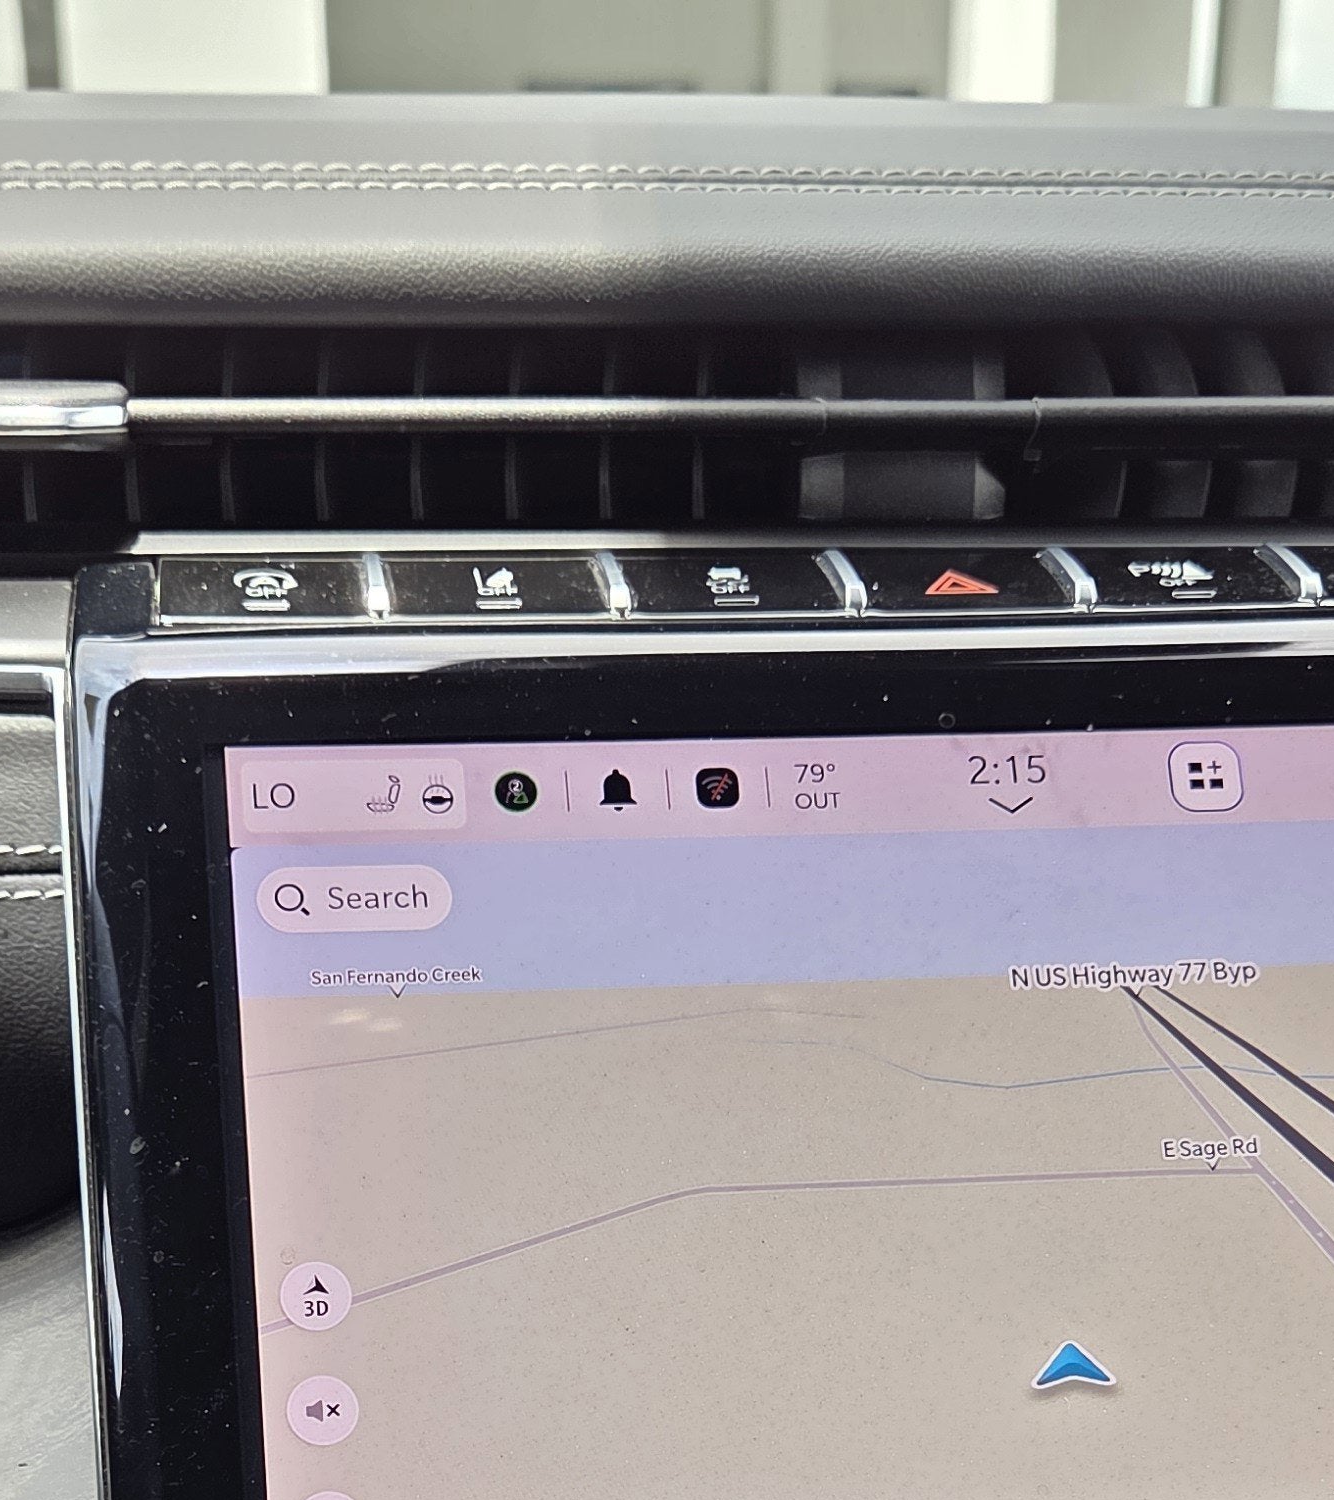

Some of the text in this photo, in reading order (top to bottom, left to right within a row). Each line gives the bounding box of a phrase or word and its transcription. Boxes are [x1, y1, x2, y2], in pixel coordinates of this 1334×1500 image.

[793, 763, 836, 784] 79°
[968, 755, 1047, 785] 2:15
[253, 782, 296, 810] LO
[794, 792, 841, 810] OUT
[327, 883, 429, 910] Search
[311, 967, 481, 986] San Fernando Creek
[1012, 961, 1257, 989] N US Highway 77 Byp
[1164, 1138, 1258, 1160] E Sage Rd
[304, 1300, 329, 1317] 3D
